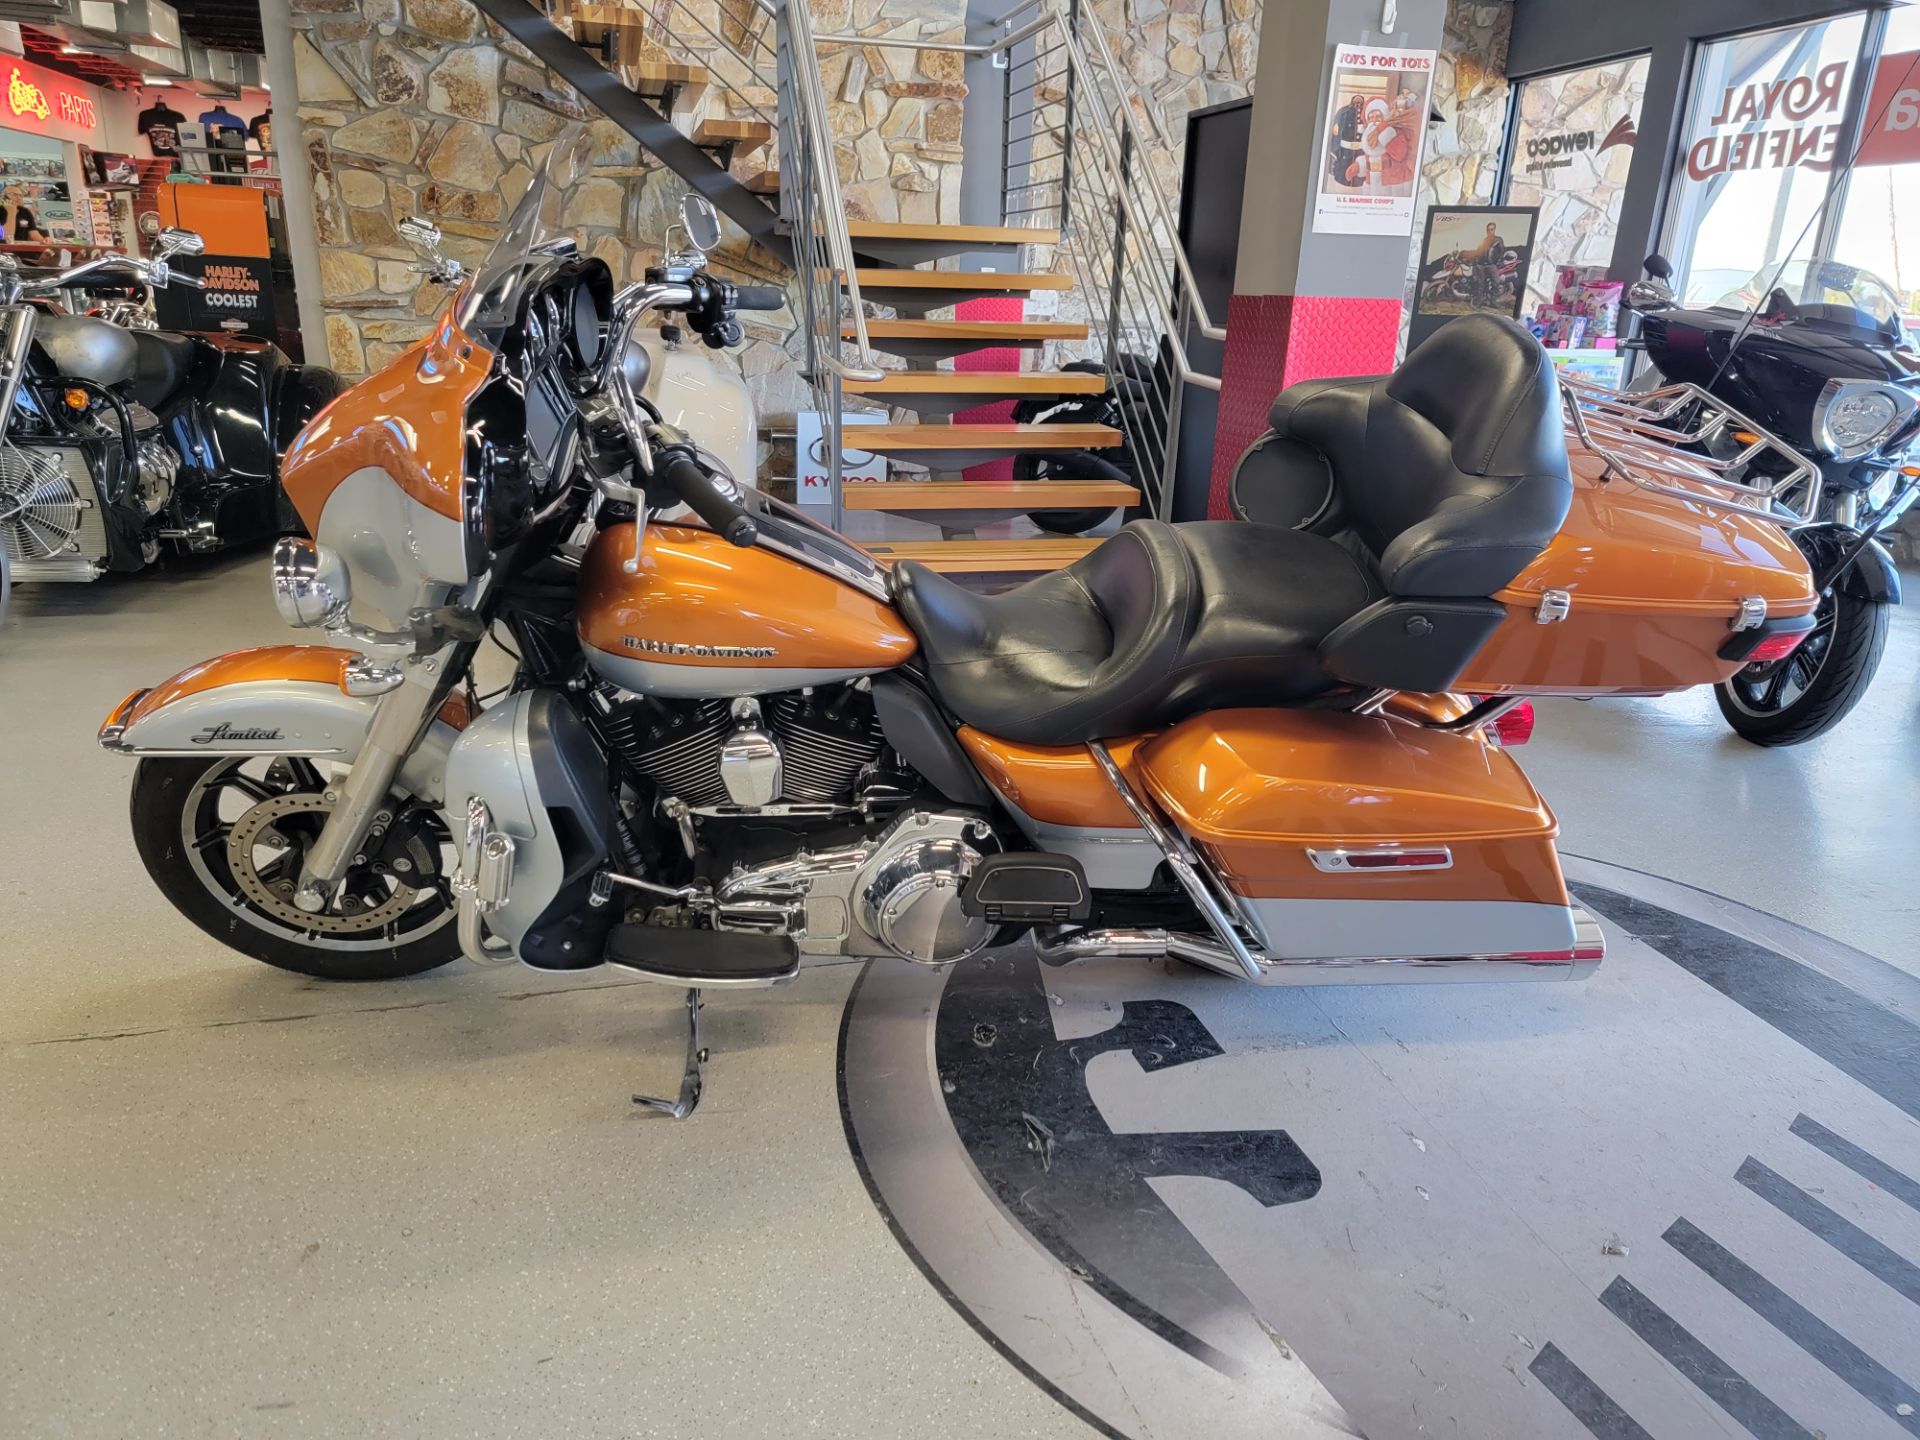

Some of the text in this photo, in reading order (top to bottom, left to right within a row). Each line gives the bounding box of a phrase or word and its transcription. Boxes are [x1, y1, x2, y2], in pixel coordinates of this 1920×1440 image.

[1340, 53, 1430, 69] TOYS FOR TOTS
[59, 91, 97, 128] PARTS
[204, 265, 251, 279] HARLEY-
[201, 276, 260, 291] DAVIDSON
[205, 292, 258, 308] COOLEST
[190, 722, 285, 744] Limited
